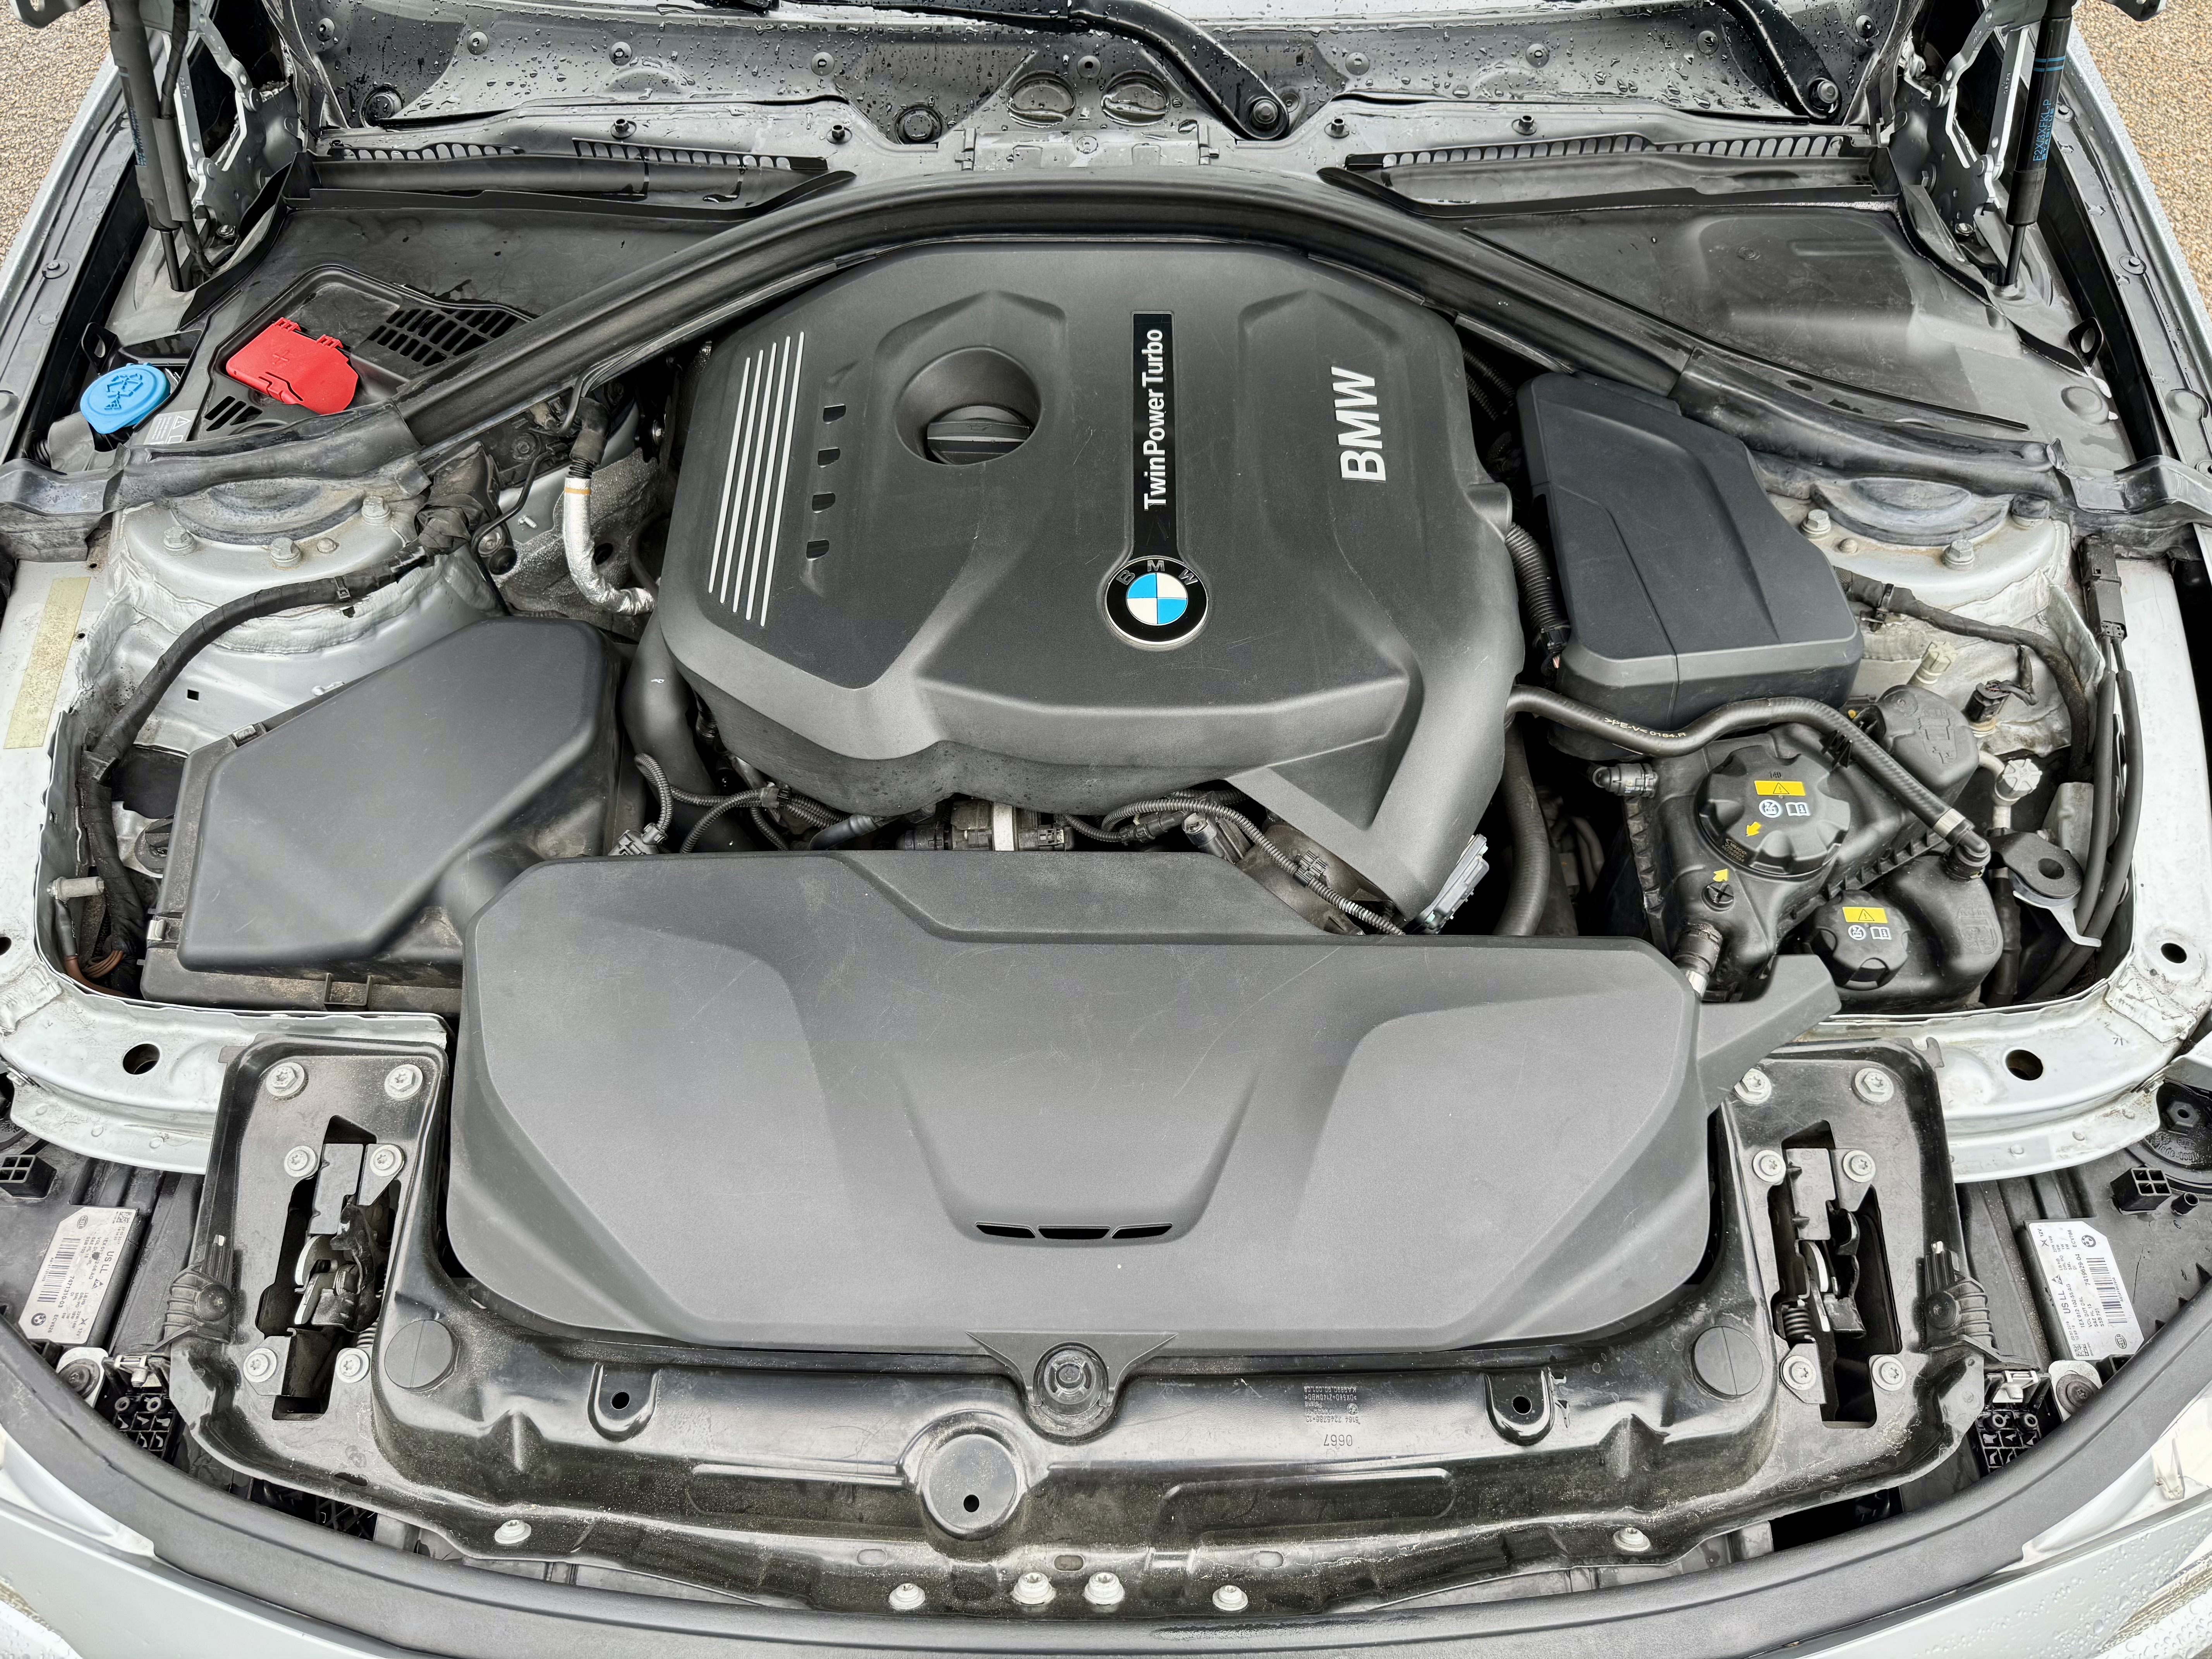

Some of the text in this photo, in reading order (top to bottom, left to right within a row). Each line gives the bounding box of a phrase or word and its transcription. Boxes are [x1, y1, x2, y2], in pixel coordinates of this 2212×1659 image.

[1142, 329, 1166, 511] TwinPower Turbo
[1331, 366, 1386, 481] BMW
[99, 1251, 115, 1274] US LL
[57, 1276, 75, 1308] 7471310-03
[2056, 1290, 2071, 1314] US LL
[1324, 1434, 1353, 1446] 0667
